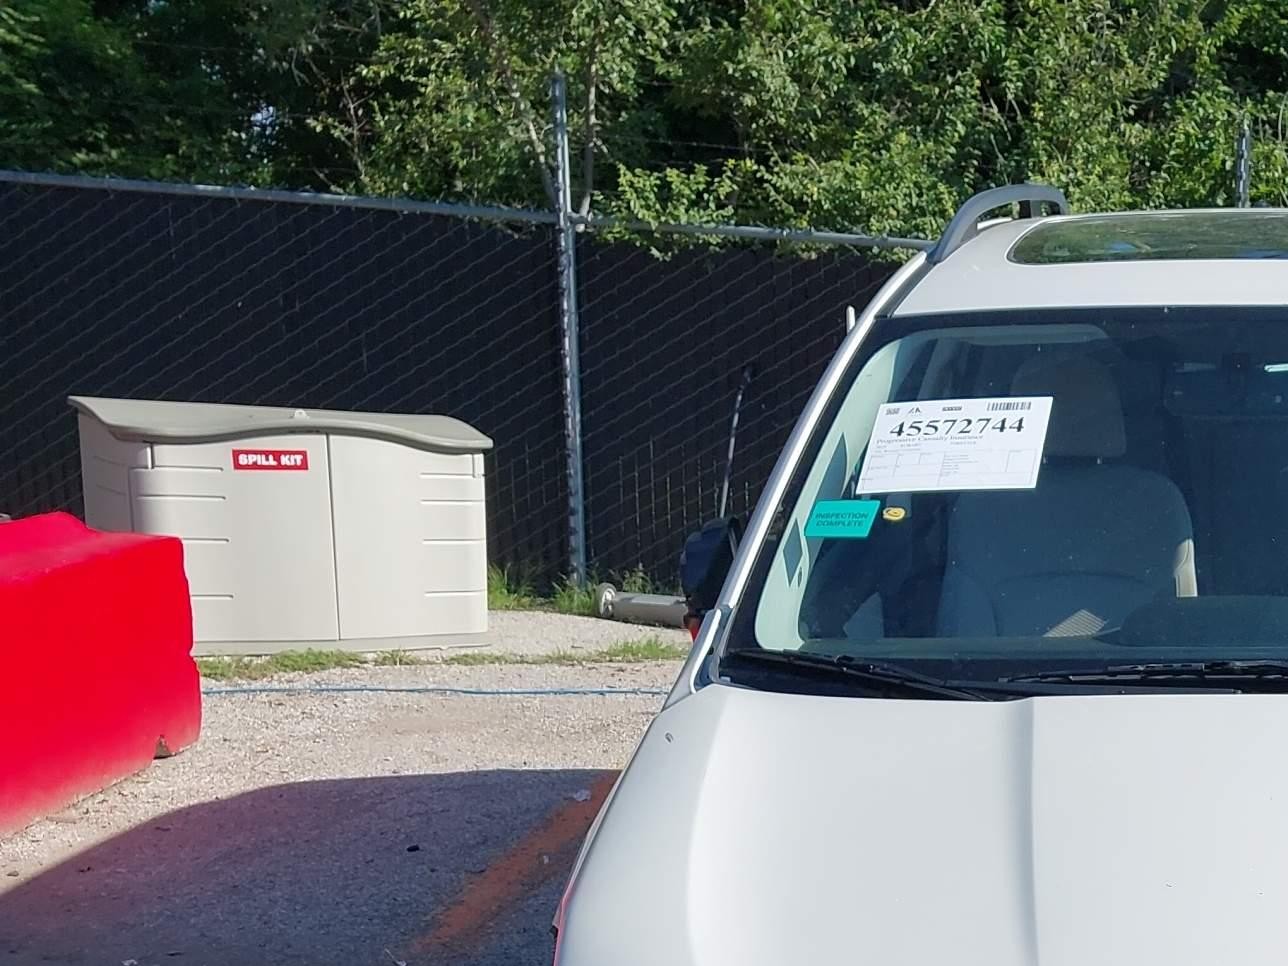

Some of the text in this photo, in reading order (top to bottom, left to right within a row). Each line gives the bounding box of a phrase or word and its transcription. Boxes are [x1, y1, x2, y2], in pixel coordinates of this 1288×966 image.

[890, 417, 1024, 437] 45572744
[238, 453, 303, 466] SPILL KIT
